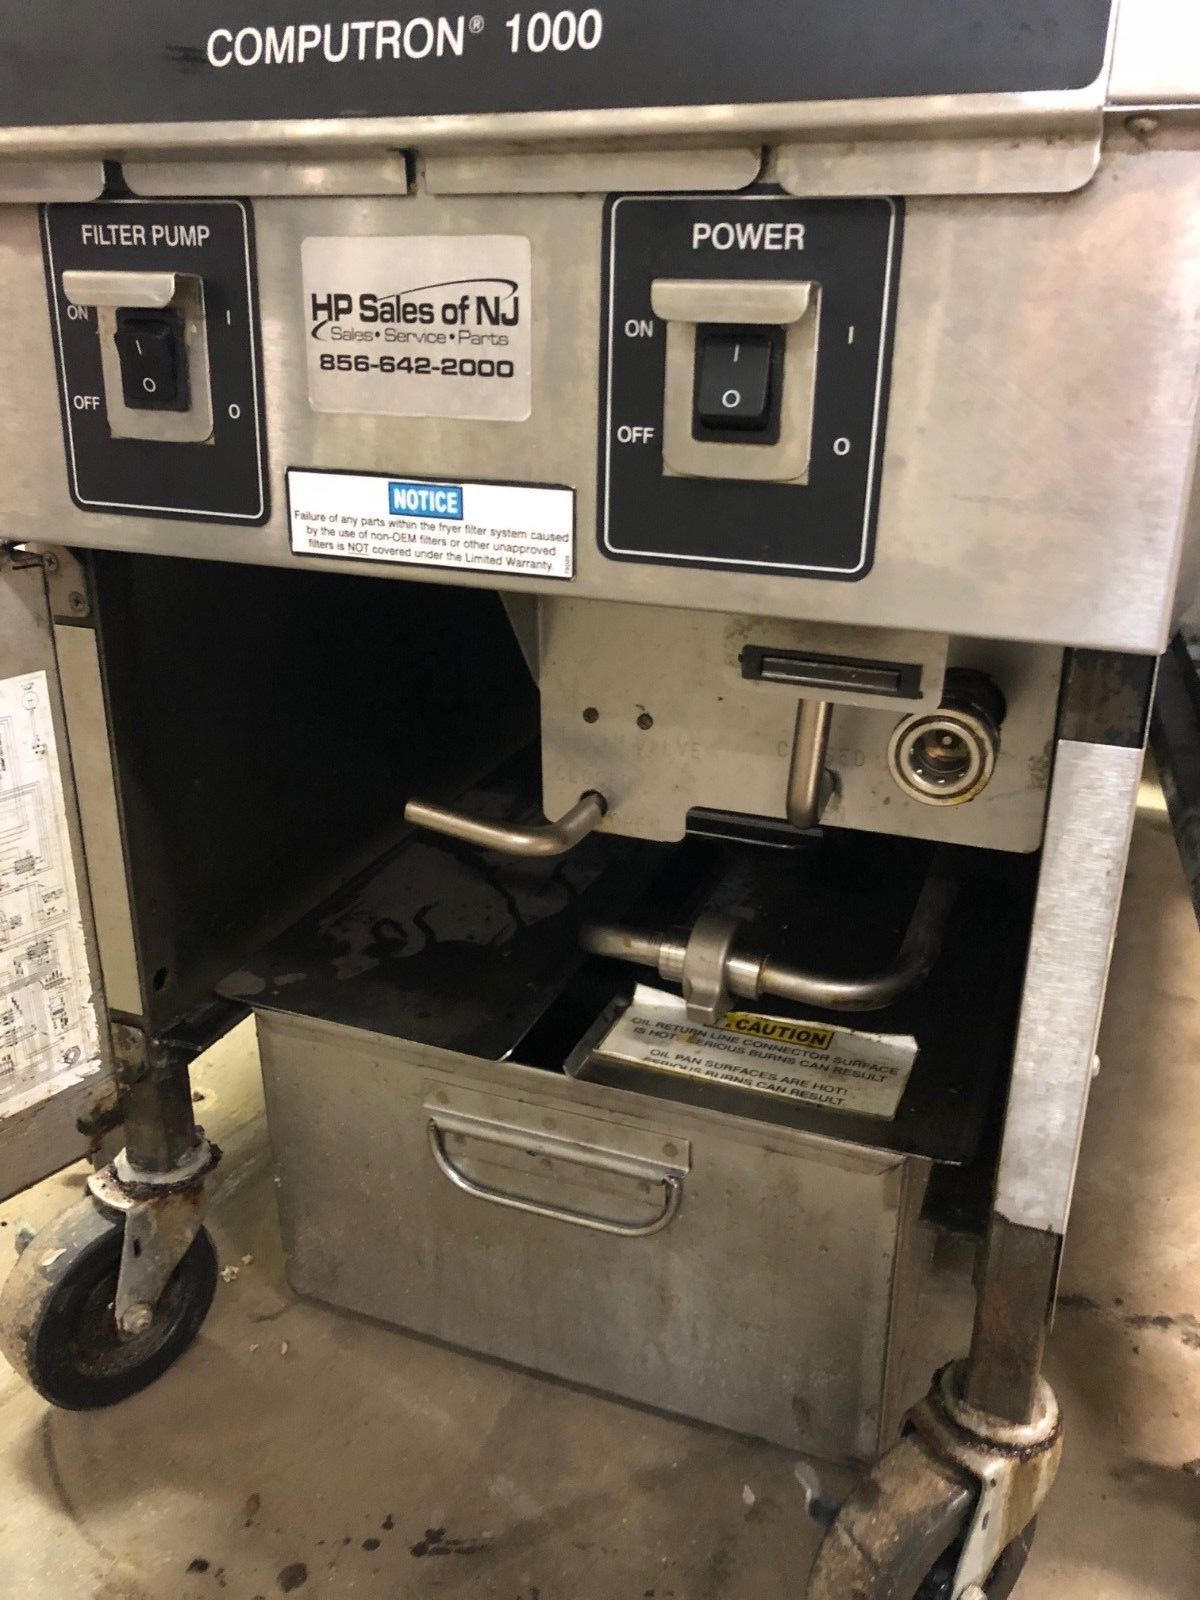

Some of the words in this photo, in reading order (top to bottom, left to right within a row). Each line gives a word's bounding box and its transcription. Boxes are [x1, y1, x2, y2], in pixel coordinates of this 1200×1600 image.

[505, 8, 602, 53] 1000
[81, 224, 146, 246] FILTER
[151, 225, 211, 247] PUMP
[692, 223, 806, 251] POWER
[67, 305, 88, 320] ON
[311, 293, 353, 322] HP
[359, 293, 435, 324] Sales
[441, 295, 470, 325] of
[476, 296, 520, 327] NJ
[458, 330, 509, 346] Parts
[624, 319, 654, 337] ON
[320, 354, 514, 378] 856-642-2000
[73, 396, 100, 410] OFF
[617, 426, 654, 443] OFF
[393, 487, 459, 514] NOTICE
[294, 510, 326, 521] Failure
[329, 513, 338, 522] of
[341, 515, 357, 526] any
[361, 517, 385, 527] parts
[388, 519, 417, 529] within
[420, 521, 436, 531] the
[439, 522, 461, 534] fryer
[465, 524, 487, 535] filter
[490, 528, 527, 539] system
[531, 531, 569, 542] caused
[307, 525, 317, 536] by
[320, 526, 335, 536] the
[339, 530, 355, 538] use
[359, 530, 368, 539] of
[371, 532, 417, 543] non-OEM
[420, 534, 447, 546] filters
[450, 539, 460, 547] or
[463, 540, 490, 550] other
[493, 543, 556, 556] unapproved
[309, 539, 334, 550] filters
[337, 541, 344, 550] is
[348, 542, 369, 554] NOT
[372, 545, 411, 557] covered
[415, 550, 443, 560] under
[447, 551, 462, 561] the
[465, 553, 502, 565] Limited
[735, 1018, 827, 1046] CAUTION
[632, 1017, 654, 1026] OIL
[656, 1021, 707, 1037] RETURN
[711, 1032, 740, 1043] LINE
[743, 1039, 830, 1061] CONNECTOR
[832, 1056, 899, 1075] SURFACE
[633, 1026, 647, 1035] IS
[688, 1037, 745, 1055] ERIOUS
[749, 1050, 796, 1065] BURNS
[800, 1060, 829, 1072] CAN
[832, 1066, 888, 1083] RESULT
[650, 1049, 673, 1059] OIL
[675, 1054, 702, 1065] PAN
[704, 1059, 777, 1081] SURFACES
[780, 1076, 809, 1088] ARE
[812, 1082, 848, 1095] HOT!
[756, 1081, 786, 1094] CAN
[790, 1088, 848, 1105] RESULT
